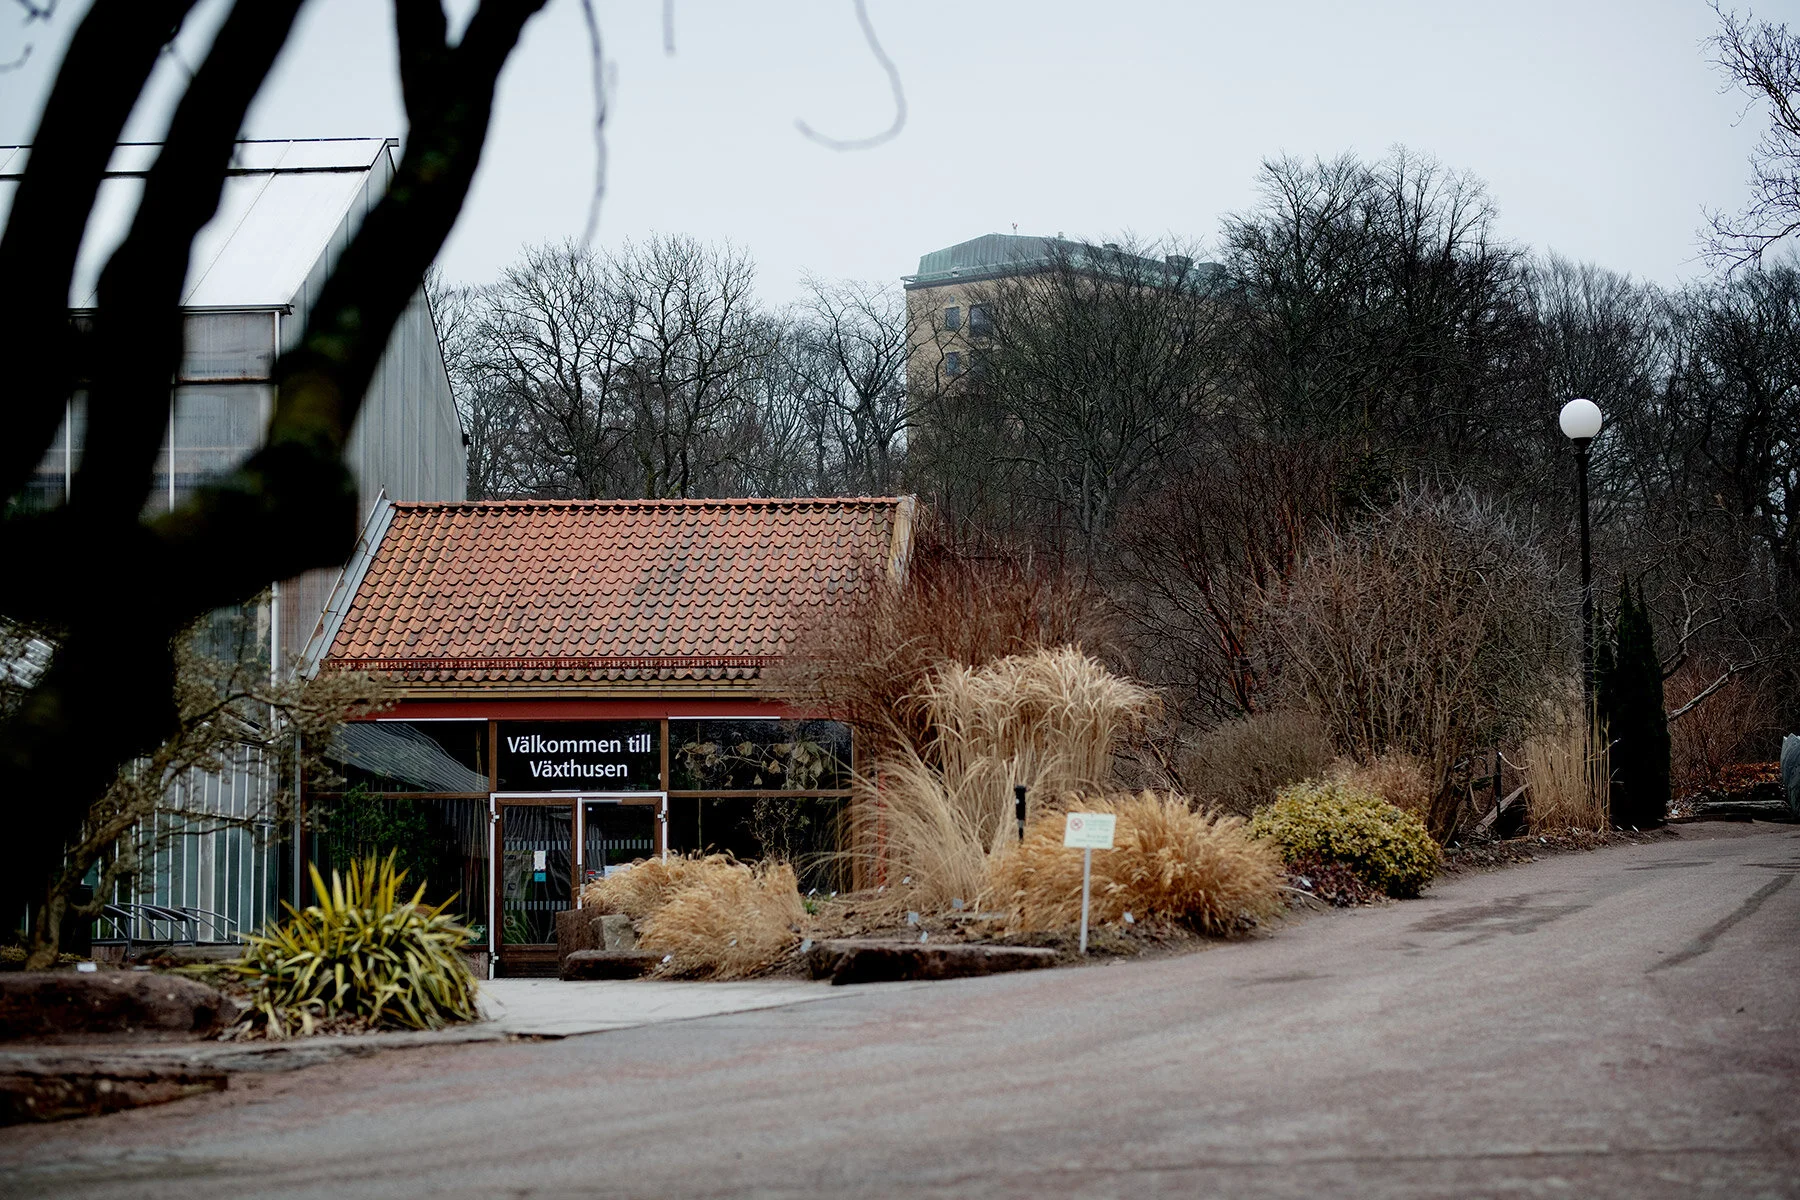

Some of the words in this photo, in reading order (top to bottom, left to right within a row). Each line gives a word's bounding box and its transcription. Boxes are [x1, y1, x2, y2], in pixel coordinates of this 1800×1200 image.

[507, 735, 621, 753] Välkommen
[627, 734, 651, 753] till
[529, 759, 628, 777] Växthusen
